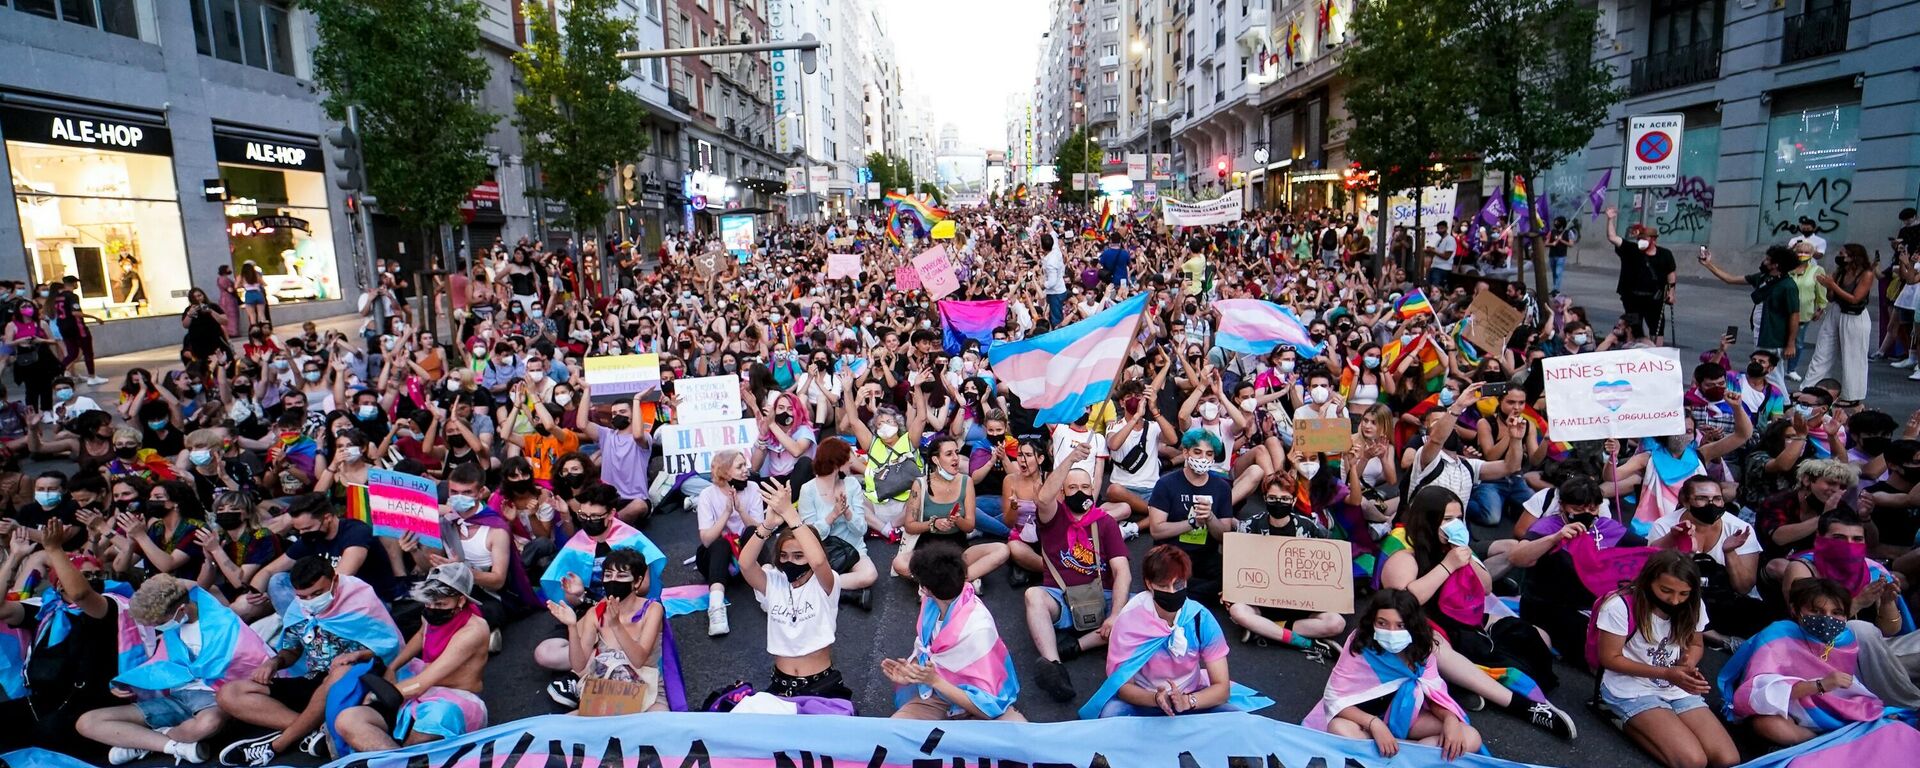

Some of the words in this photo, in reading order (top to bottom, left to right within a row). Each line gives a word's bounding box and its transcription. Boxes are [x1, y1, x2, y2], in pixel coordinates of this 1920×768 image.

[771, 49, 786, 115] HOTEL
[51, 117, 143, 148] ALE-HOP
[246, 142, 306, 165] ALE-HOP
[1775, 177, 1852, 217] FM2
[1546, 363, 1604, 380] NIÑES
[1616, 359, 1675, 374] TRANS
[1552, 416, 1610, 427] FAMILIAS
[1618, 411, 1679, 421] ORGULLOSAS
[677, 424, 749, 450] HABRA
[665, 452, 698, 474] LEY
[391, 476, 404, 486] NO
[411, 480, 429, 492] HAY
[387, 501, 424, 515] HABRA
[1285, 547, 1305, 558] ARE
[1310, 549, 1331, 560] YOU
[1284, 557, 1293, 568] A
[1296, 559, 1319, 570] BOY
[1321, 560, 1337, 572] OR
[1245, 571, 1267, 584] NO.
[1284, 568, 1293, 579] A
[1295, 570, 1329, 582] GIRL?
[1254, 596, 1266, 604] LEY
[1271, 598, 1297, 606] TRANS
[1300, 600, 1315, 609] YA!
